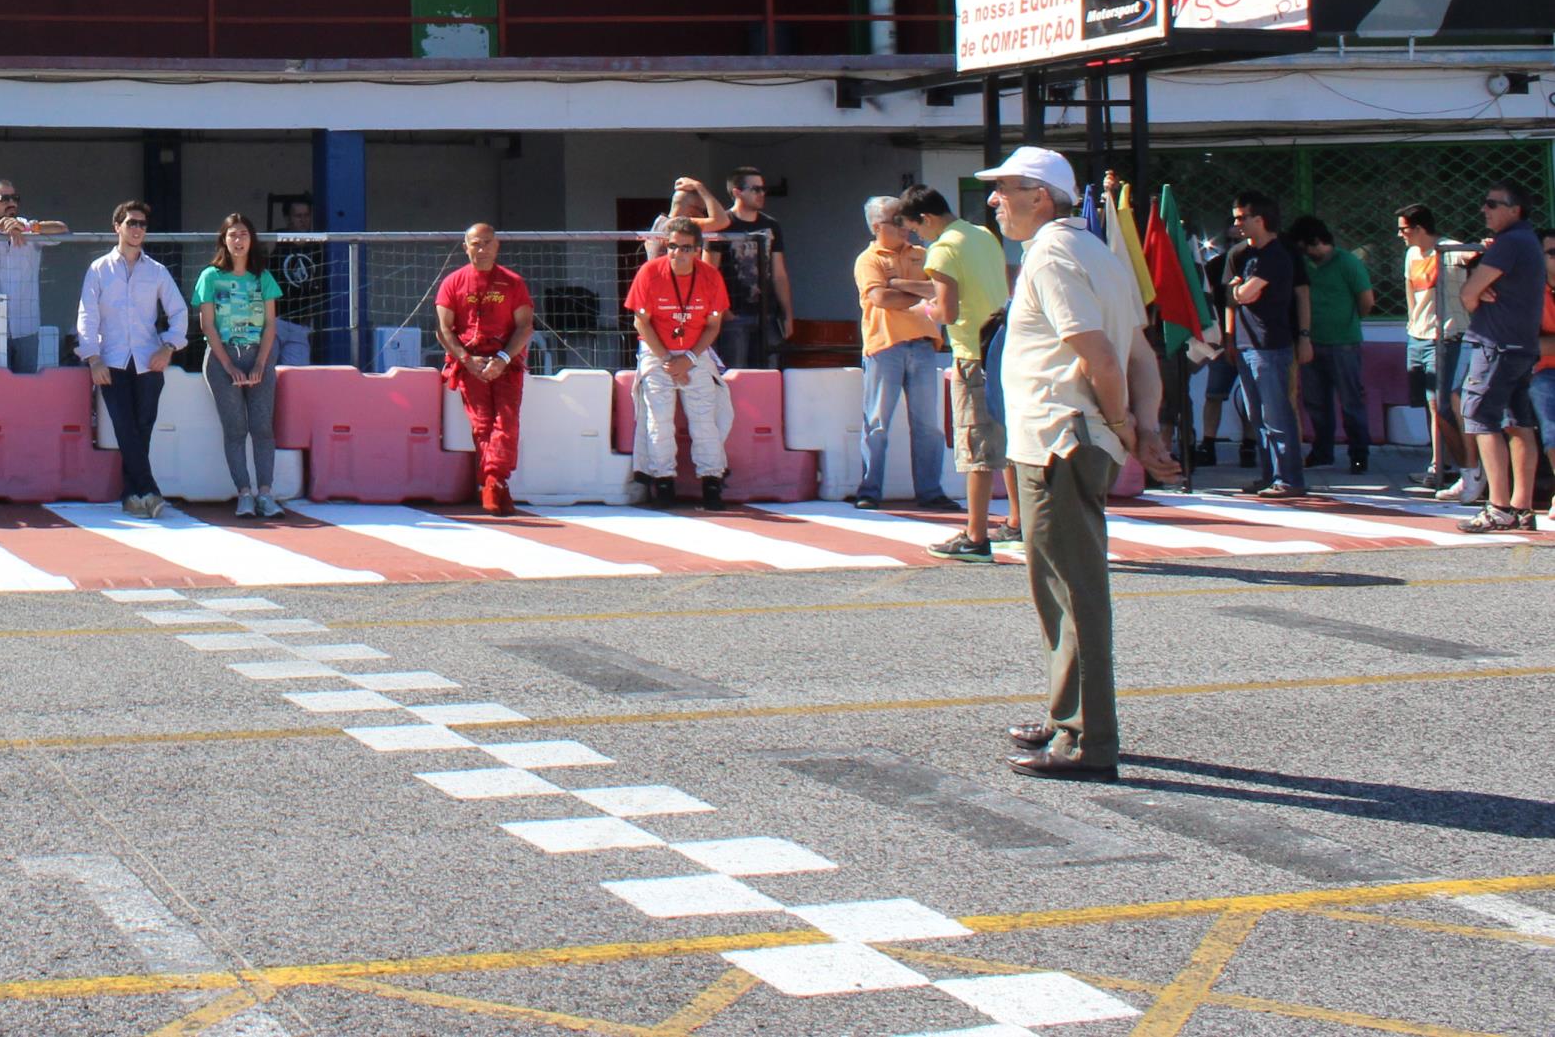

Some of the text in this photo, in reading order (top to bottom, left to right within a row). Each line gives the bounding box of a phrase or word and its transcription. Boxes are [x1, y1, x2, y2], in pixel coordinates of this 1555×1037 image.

[961, 9, 969, 24] a
[975, 1, 1014, 22] nossa
[1086, 1, 1140, 23] Motorsport
[960, 15, 1075, 58] de COMPETIÇÃO
